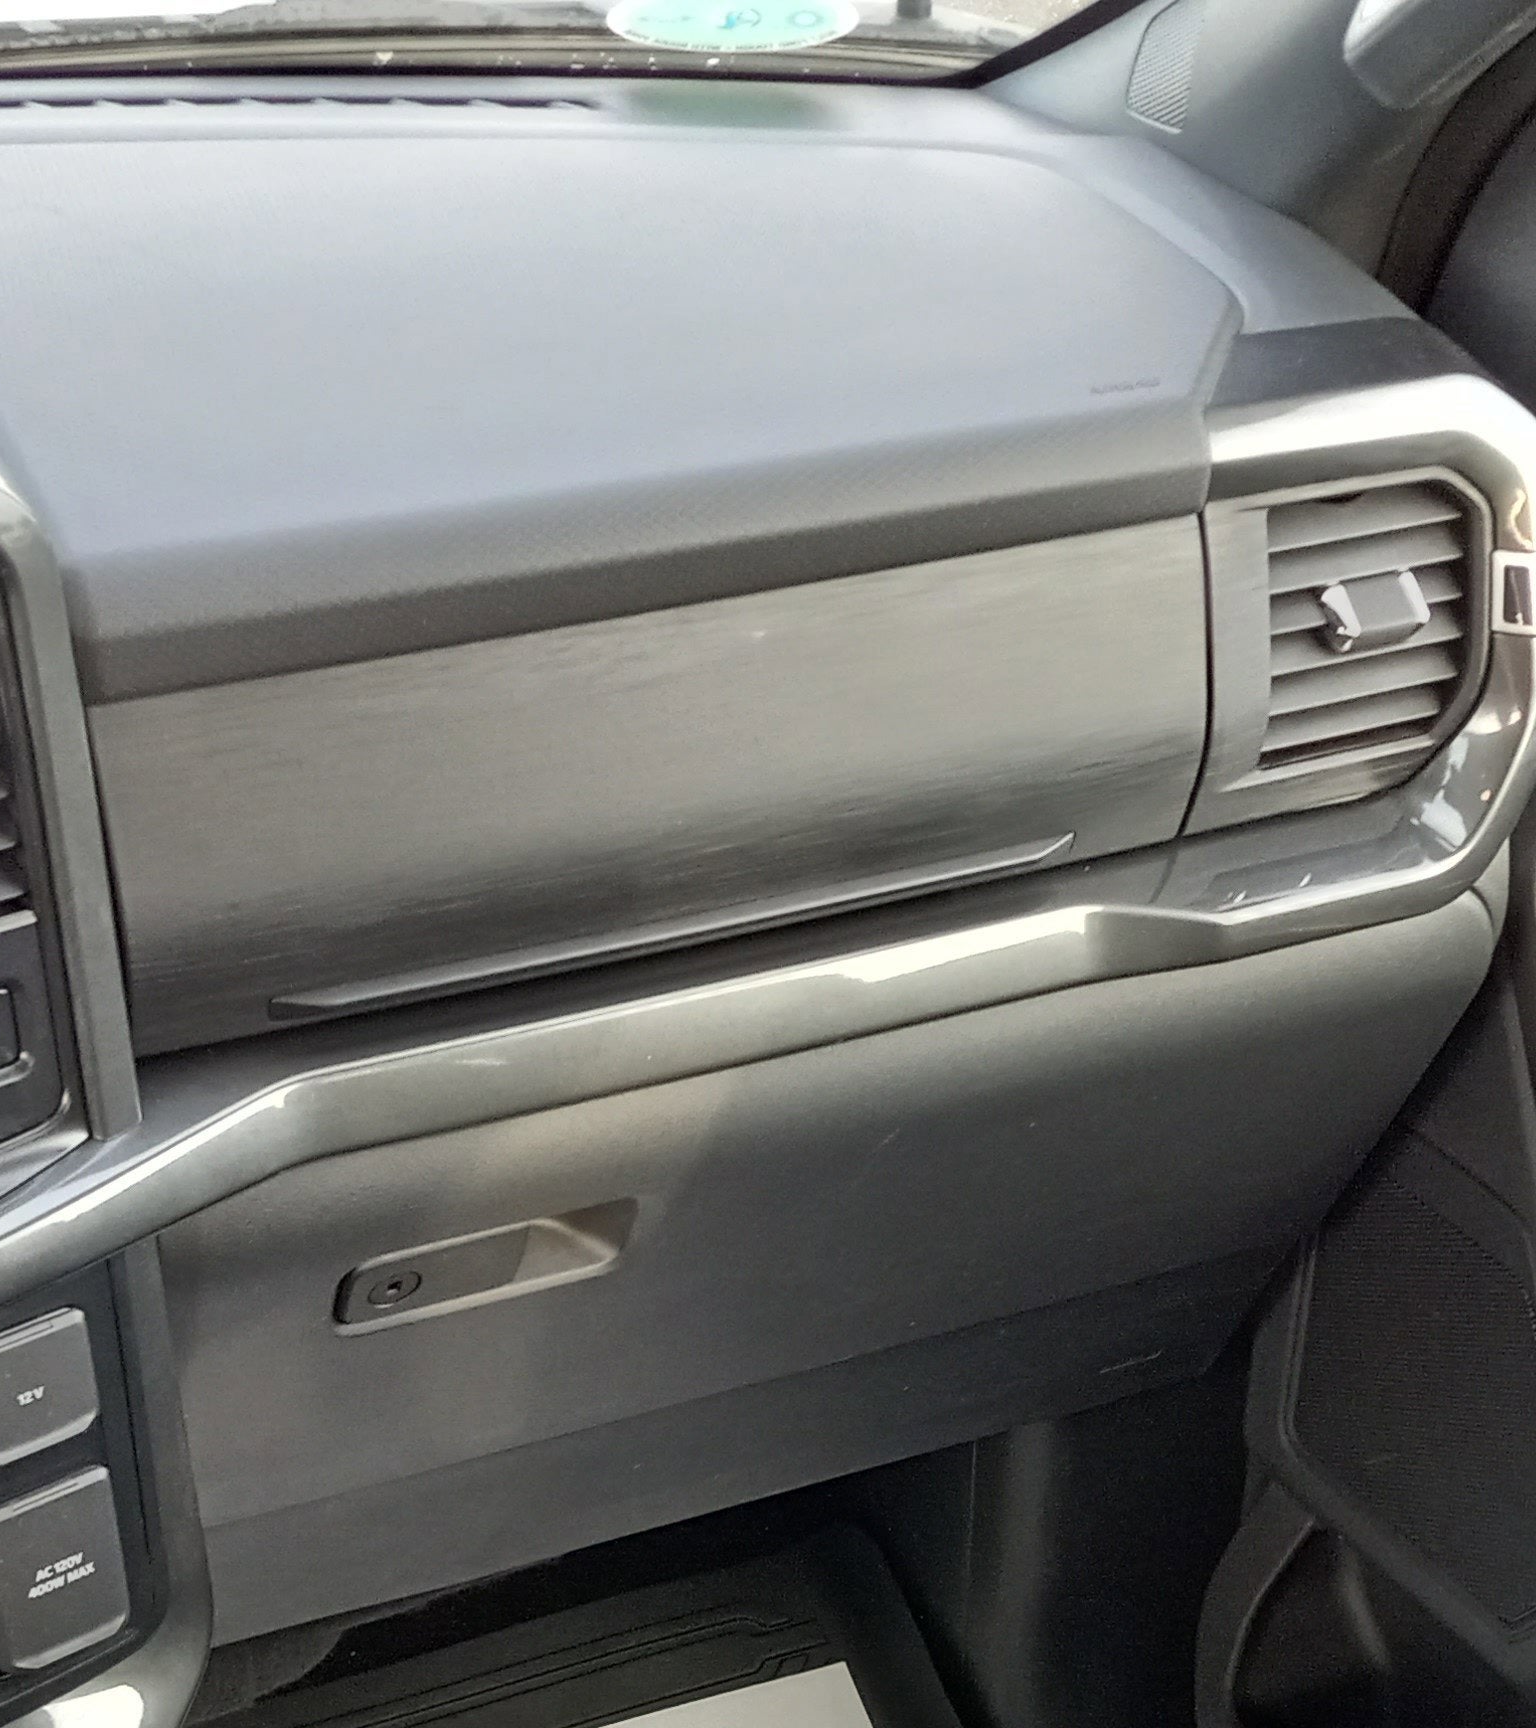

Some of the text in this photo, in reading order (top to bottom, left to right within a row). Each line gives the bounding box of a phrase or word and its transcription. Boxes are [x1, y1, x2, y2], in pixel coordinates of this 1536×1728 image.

[16, 1385, 46, 1406] 12V
[34, 1565, 54, 1583] AC
[66, 1561, 96, 1584] MAX
